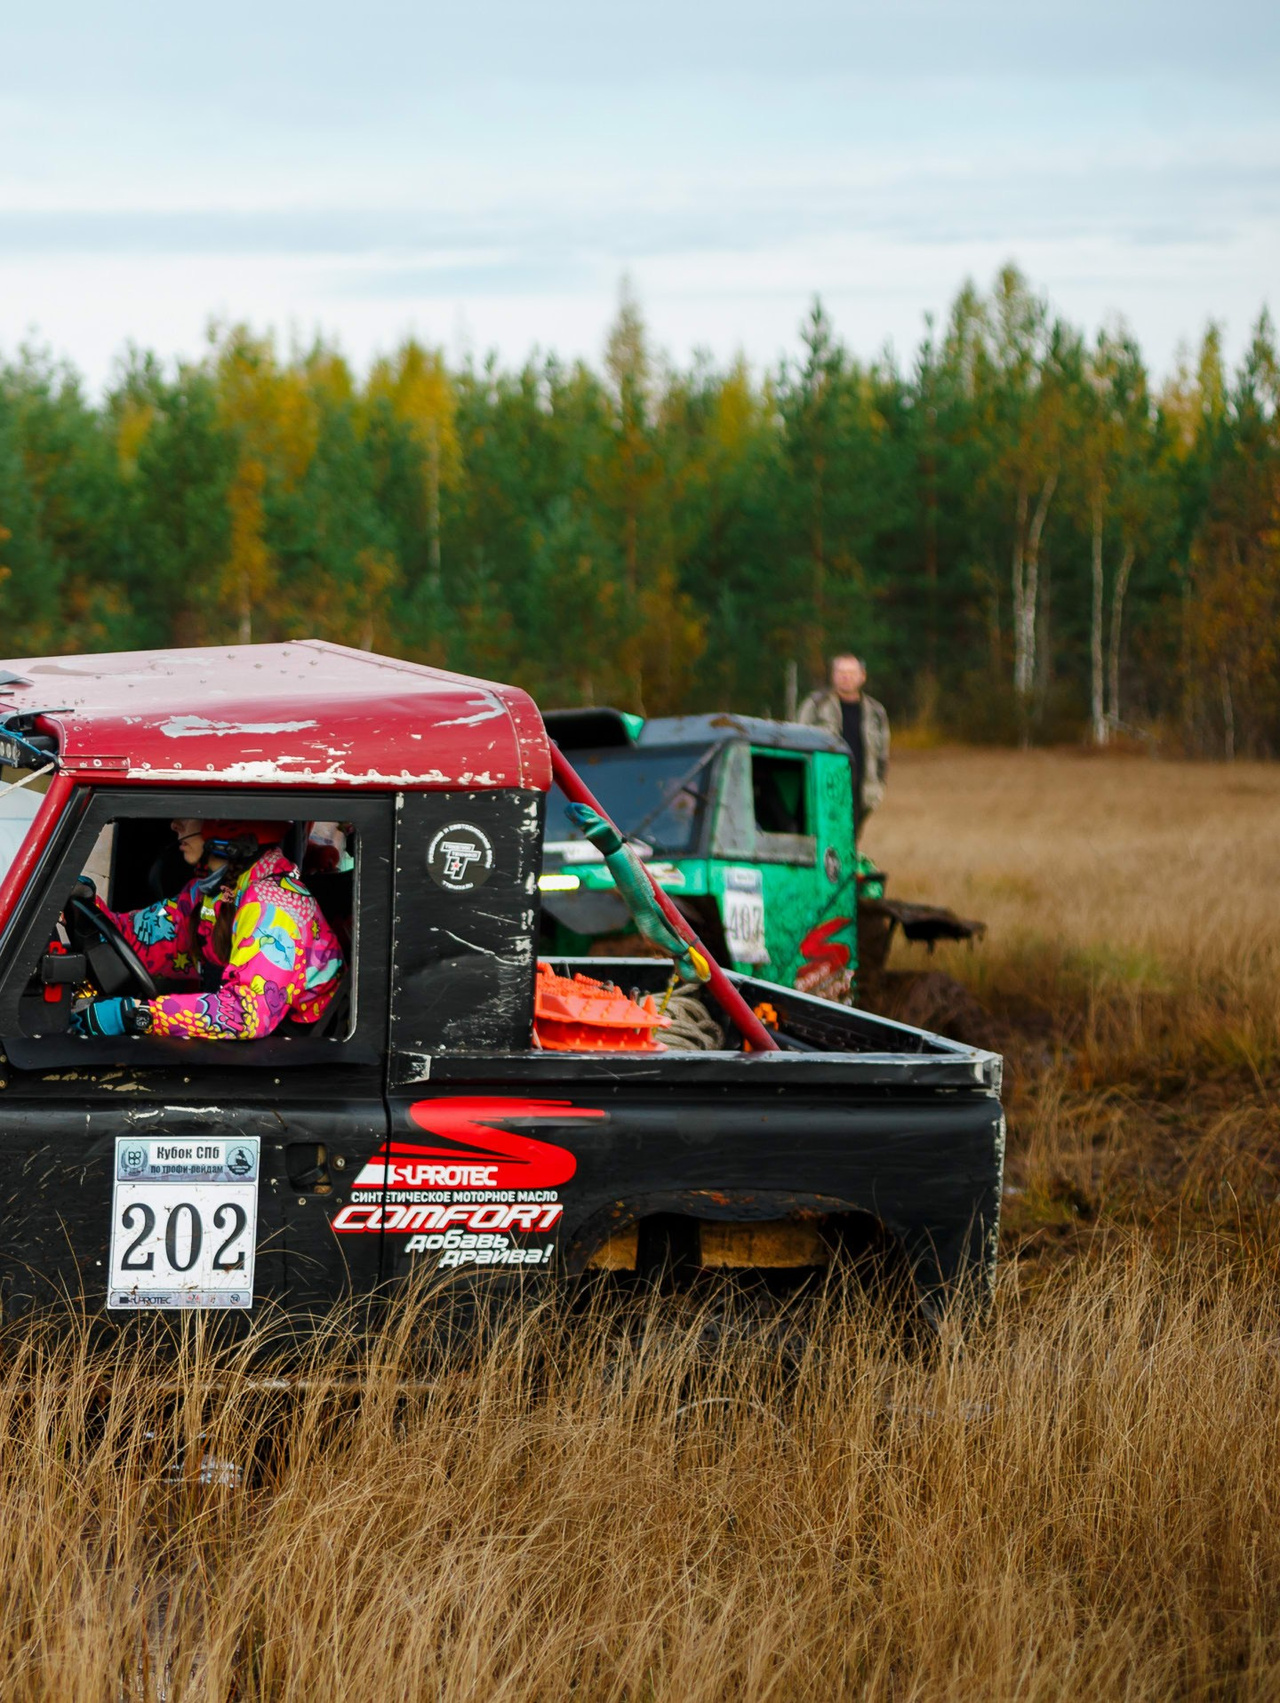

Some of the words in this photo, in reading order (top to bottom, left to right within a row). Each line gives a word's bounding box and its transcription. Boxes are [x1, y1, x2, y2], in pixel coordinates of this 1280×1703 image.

[156, 1146, 193, 1160] Кубок
[196, 1146, 220, 1159] СПб
[150, 1165, 161, 1174] по
[350, 1190, 451, 1203] СИНТЕТИЧЕСКОЕ
[455, 1190, 516, 1203] МОТОРНОЕ
[517, 1190, 558, 1203] МАСЛО
[331, 1203, 564, 1232] COMFORT
[120, 1202, 248, 1272] 202
[404, 1228, 510, 1253] добавь
[438, 1243, 555, 1268] драйва!
